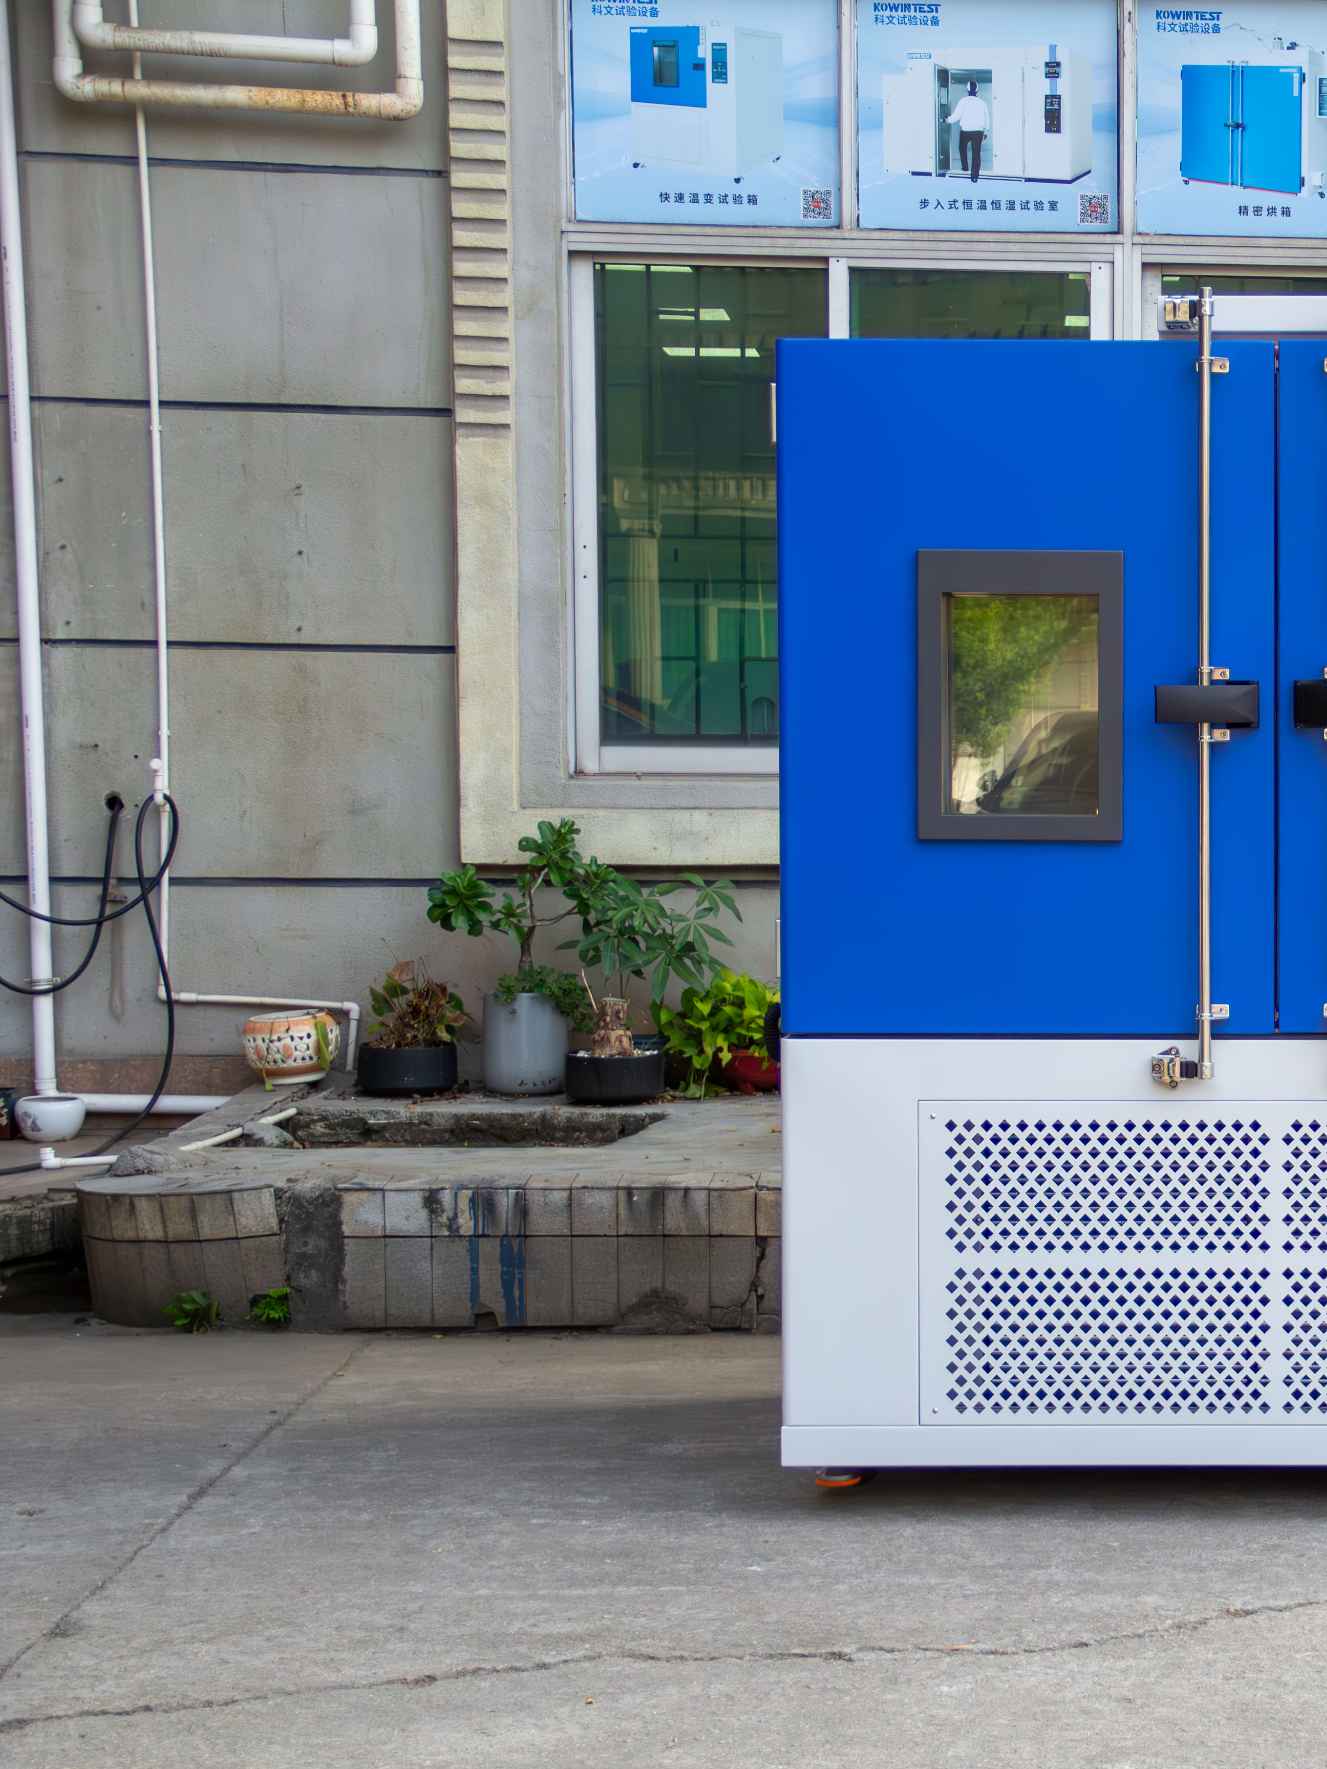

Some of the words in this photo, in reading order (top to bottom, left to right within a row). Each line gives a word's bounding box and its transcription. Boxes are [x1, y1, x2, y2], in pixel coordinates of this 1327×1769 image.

[592, 4, 659, 17] 科文试验设备
[873, 2, 941, 14] KOWINTEST
[873, 14, 940, 26] 科文试验设备
[1155, 9, 1222, 21] KOWINTEST
[1157, 21, 1221, 33] 科文试验设备
[659, 191, 759, 206] 快速温变试验箱
[919, 197, 1059, 212] 步入式恒温恒湿试验室
[1238, 205, 1292, 218] 精密烘箱
